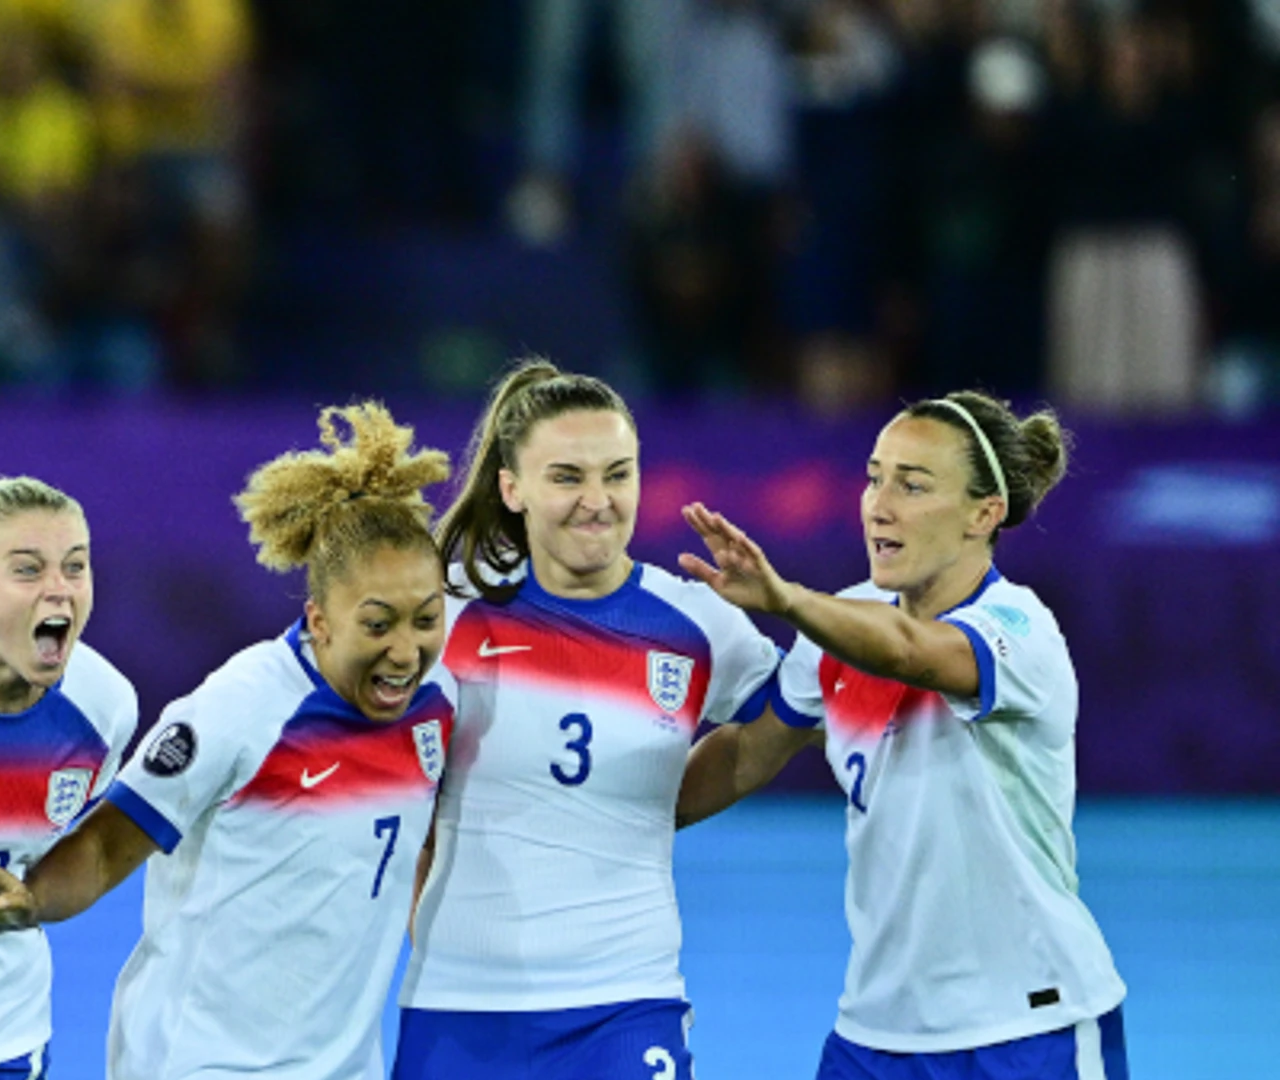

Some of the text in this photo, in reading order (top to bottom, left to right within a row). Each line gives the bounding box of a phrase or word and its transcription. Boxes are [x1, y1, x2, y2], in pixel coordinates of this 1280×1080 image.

[550, 712, 593, 786] 3
[845, 751, 867, 814] 2
[371, 814, 401, 900] 7
